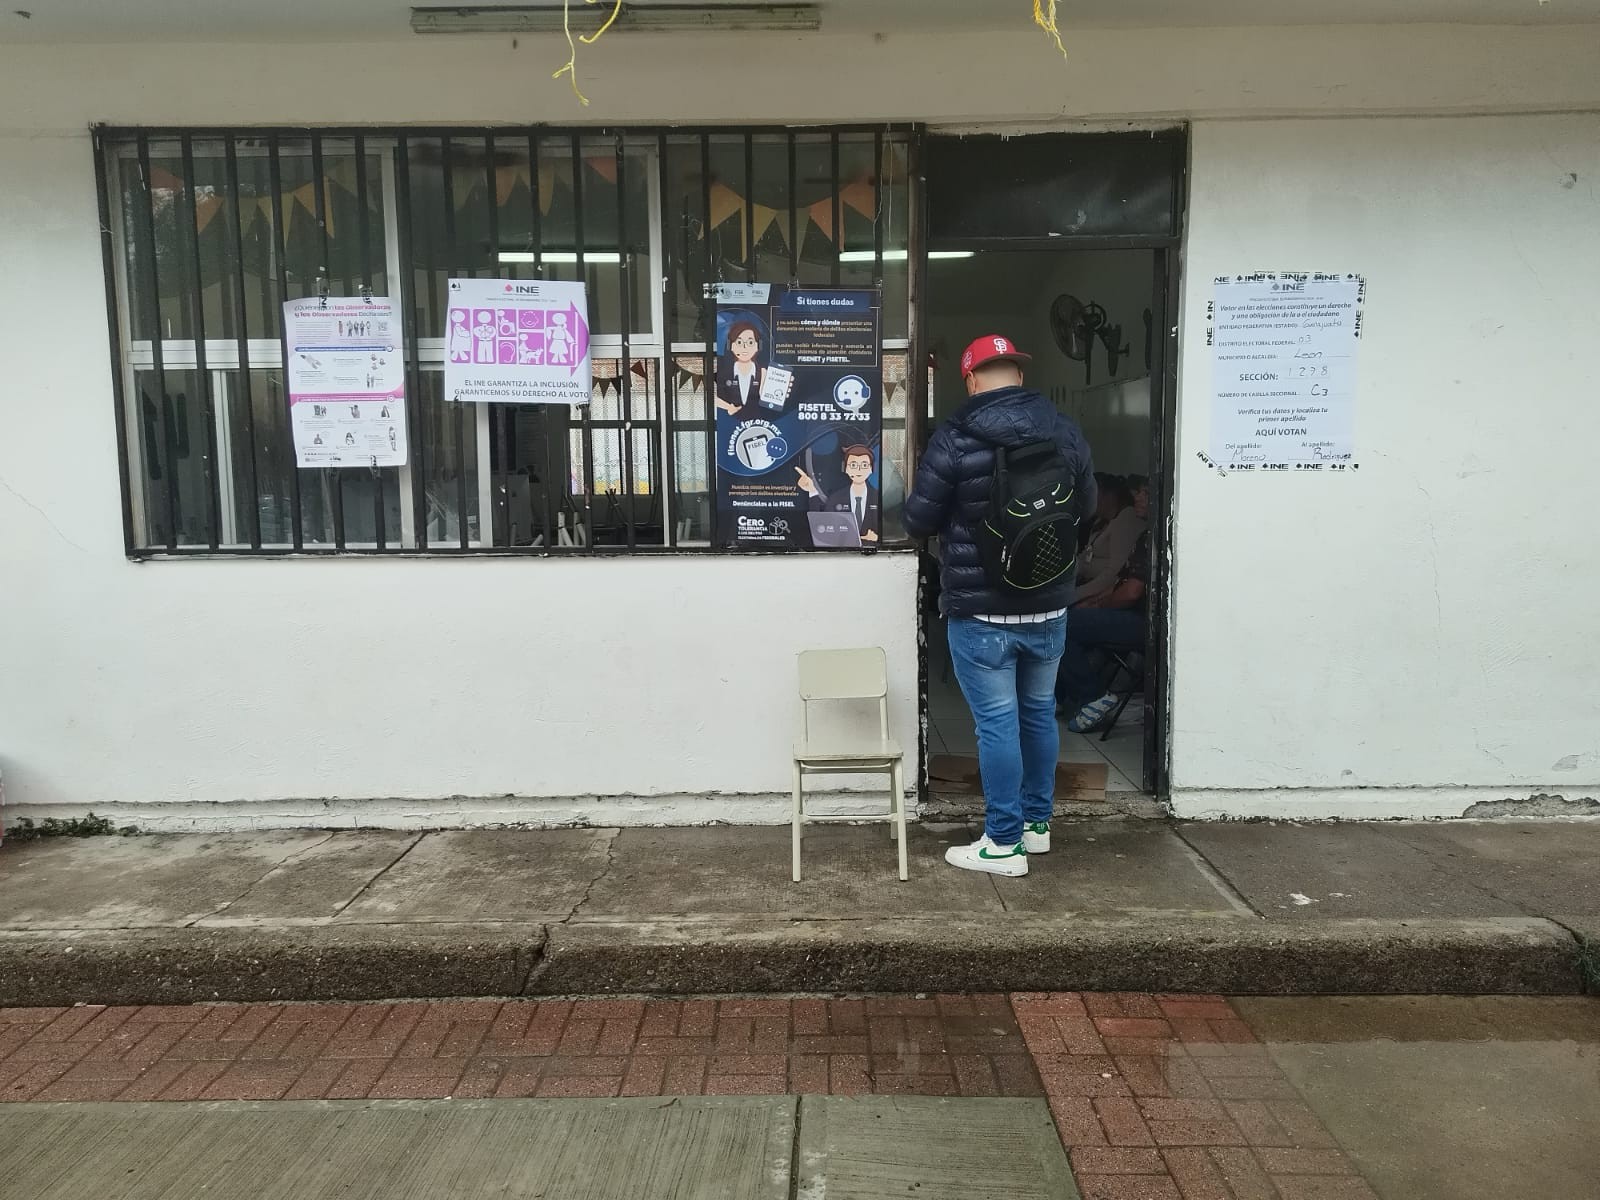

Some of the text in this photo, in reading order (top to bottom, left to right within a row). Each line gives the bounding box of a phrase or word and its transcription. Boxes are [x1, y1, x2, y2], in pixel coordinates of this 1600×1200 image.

[516, 285, 540, 294] INE
[1282, 283, 1305, 291] INE
[796, 296, 806, 305] Si
[831, 298, 855, 306] dudas
[1256, 303, 1286, 311] elecciones
[1239, 372, 1279, 381] SECCIÓN:
[464, 379, 472, 387] EL
[487, 380, 528, 388] GARANTIZA
[529, 380, 539, 388] LA
[540, 381, 580, 389] INCLUSIÓN
[454, 388, 510, 397] GARANTICEMOS
[511, 389, 521, 397] SU
[522, 390, 557, 398] DERECHO
[570, 391, 589, 399] VOTO
[798, 403, 837, 412] FISETEL
[1273, 407, 1291, 415] datos
[798, 412, 871, 421] 800 8 33 72 33
[1280, 414, 1307, 423] apellido
[1255, 427, 1307, 437] AQUÍ VOTAN
